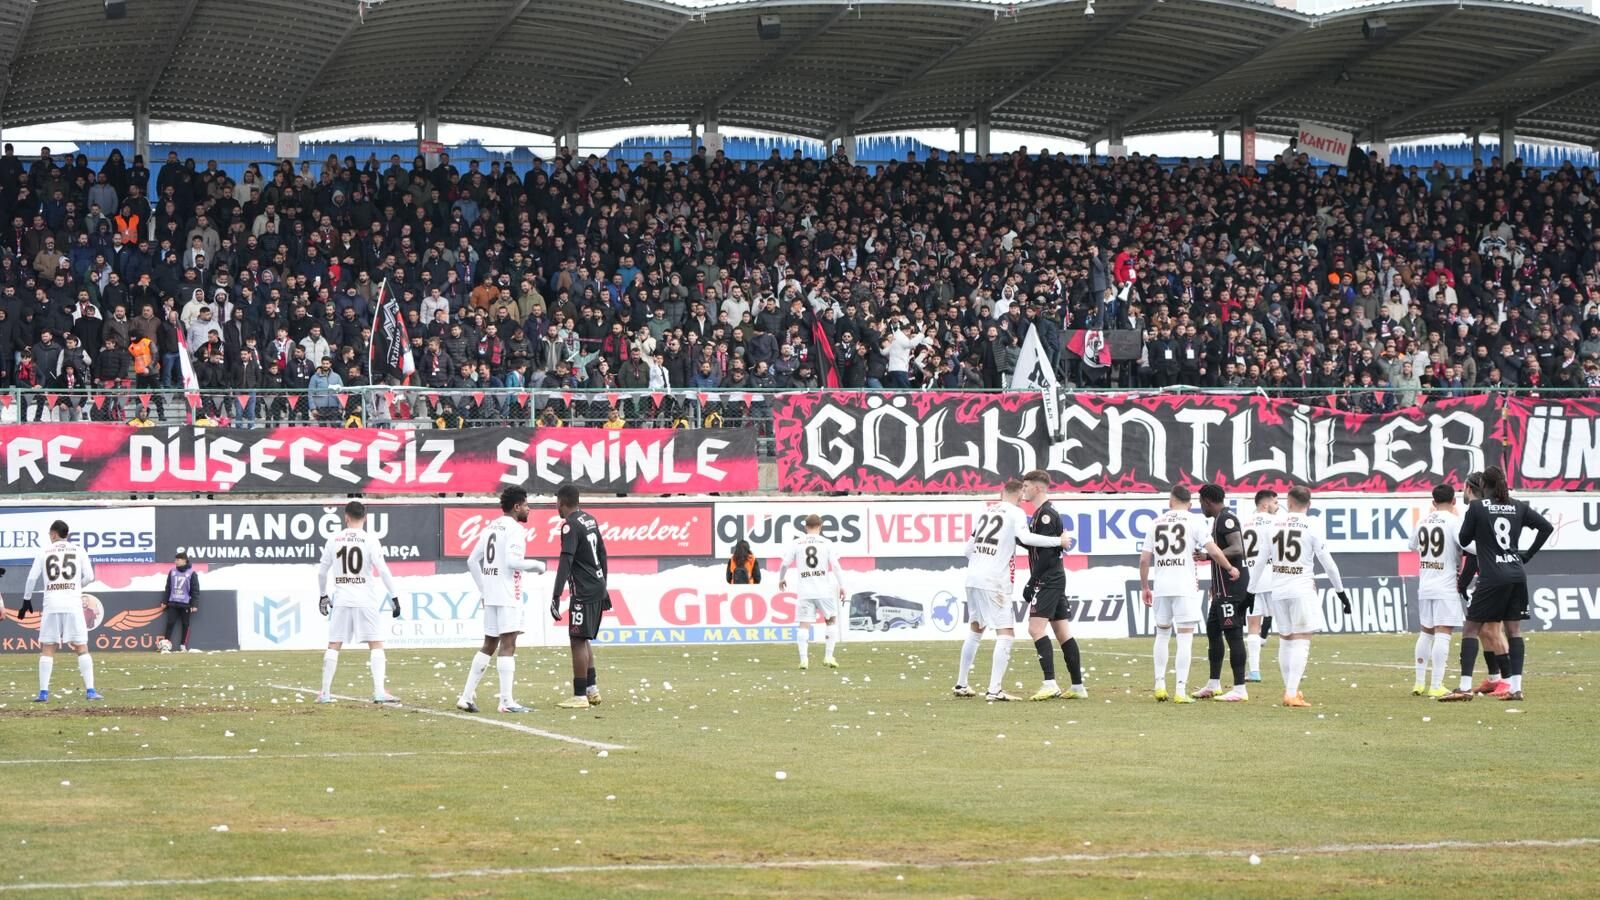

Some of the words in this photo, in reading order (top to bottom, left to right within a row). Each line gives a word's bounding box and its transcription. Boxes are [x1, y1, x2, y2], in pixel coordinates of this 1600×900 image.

[1300, 131, 1347, 156] KANTİN
[804, 395, 1487, 484] GÖLKENTLİLER
[0, 435, 84, 485] RE
[129, 426, 456, 490] DÜŞECEĞİZ
[496, 431, 731, 486] SENİNLE
[208, 506, 389, 540] HANOĞU
[974, 514, 1003, 546] 22
[1307, 507, 1409, 541] ELİK
[1494, 517, 1511, 550] 8
[382, 545, 420, 559] ARÇA
[487, 533, 497, 564] 6
[1154, 523, 1186, 556] 53
[1243, 529, 1259, 558] 2
[1272, 529, 1302, 563] 15
[1418, 526, 1444, 558] 99
[45, 554, 77, 581] 65
[336, 546, 363, 574] 10
[805, 545, 818, 568] 8
[174, 576, 186, 589] 17
[571, 611, 584, 625] 19
[659, 587, 825, 627] Gros
[1221, 603, 1235, 618] 13
[391, 622, 464, 635] GRUP
[599, 628, 686, 644] OPTAN
[703, 626, 800, 642] MARKE
